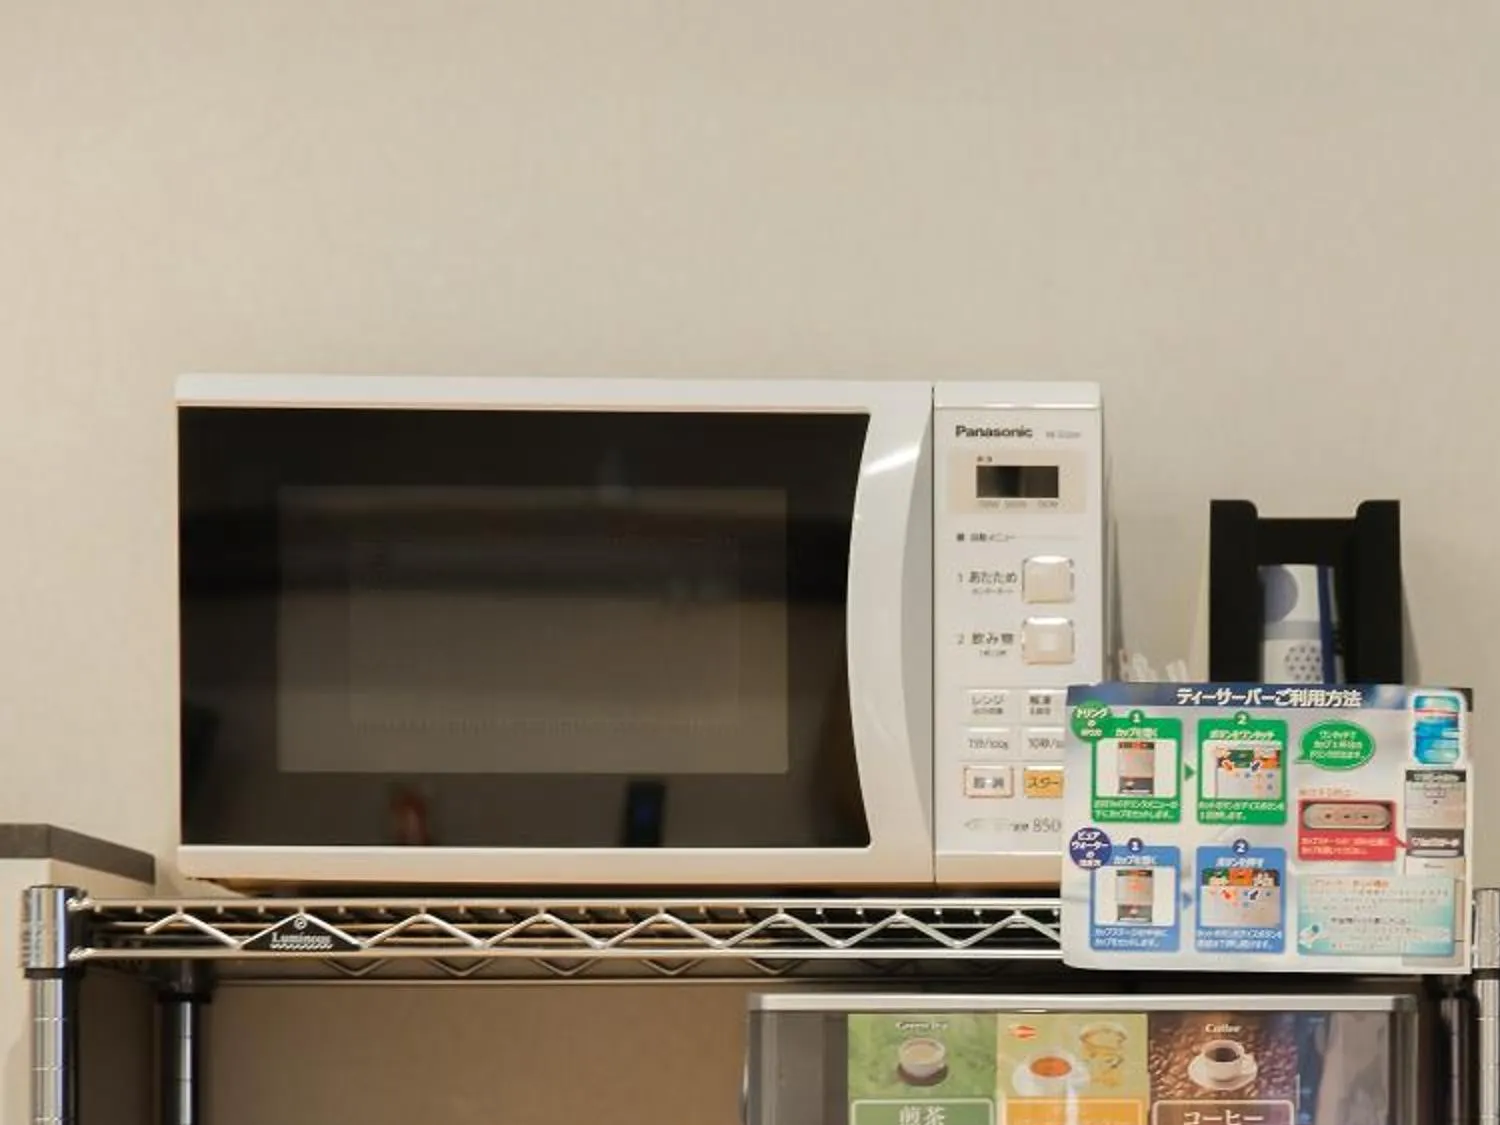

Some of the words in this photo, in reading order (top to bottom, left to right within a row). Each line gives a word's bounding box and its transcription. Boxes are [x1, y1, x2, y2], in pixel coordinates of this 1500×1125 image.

[954, 424, 1033, 438] Panasonic
[1176, 687, 1363, 708] ティーサーバーご利用方法
[1026, 775, 1060, 789] スター
[1236, 841, 1247, 853] 2
